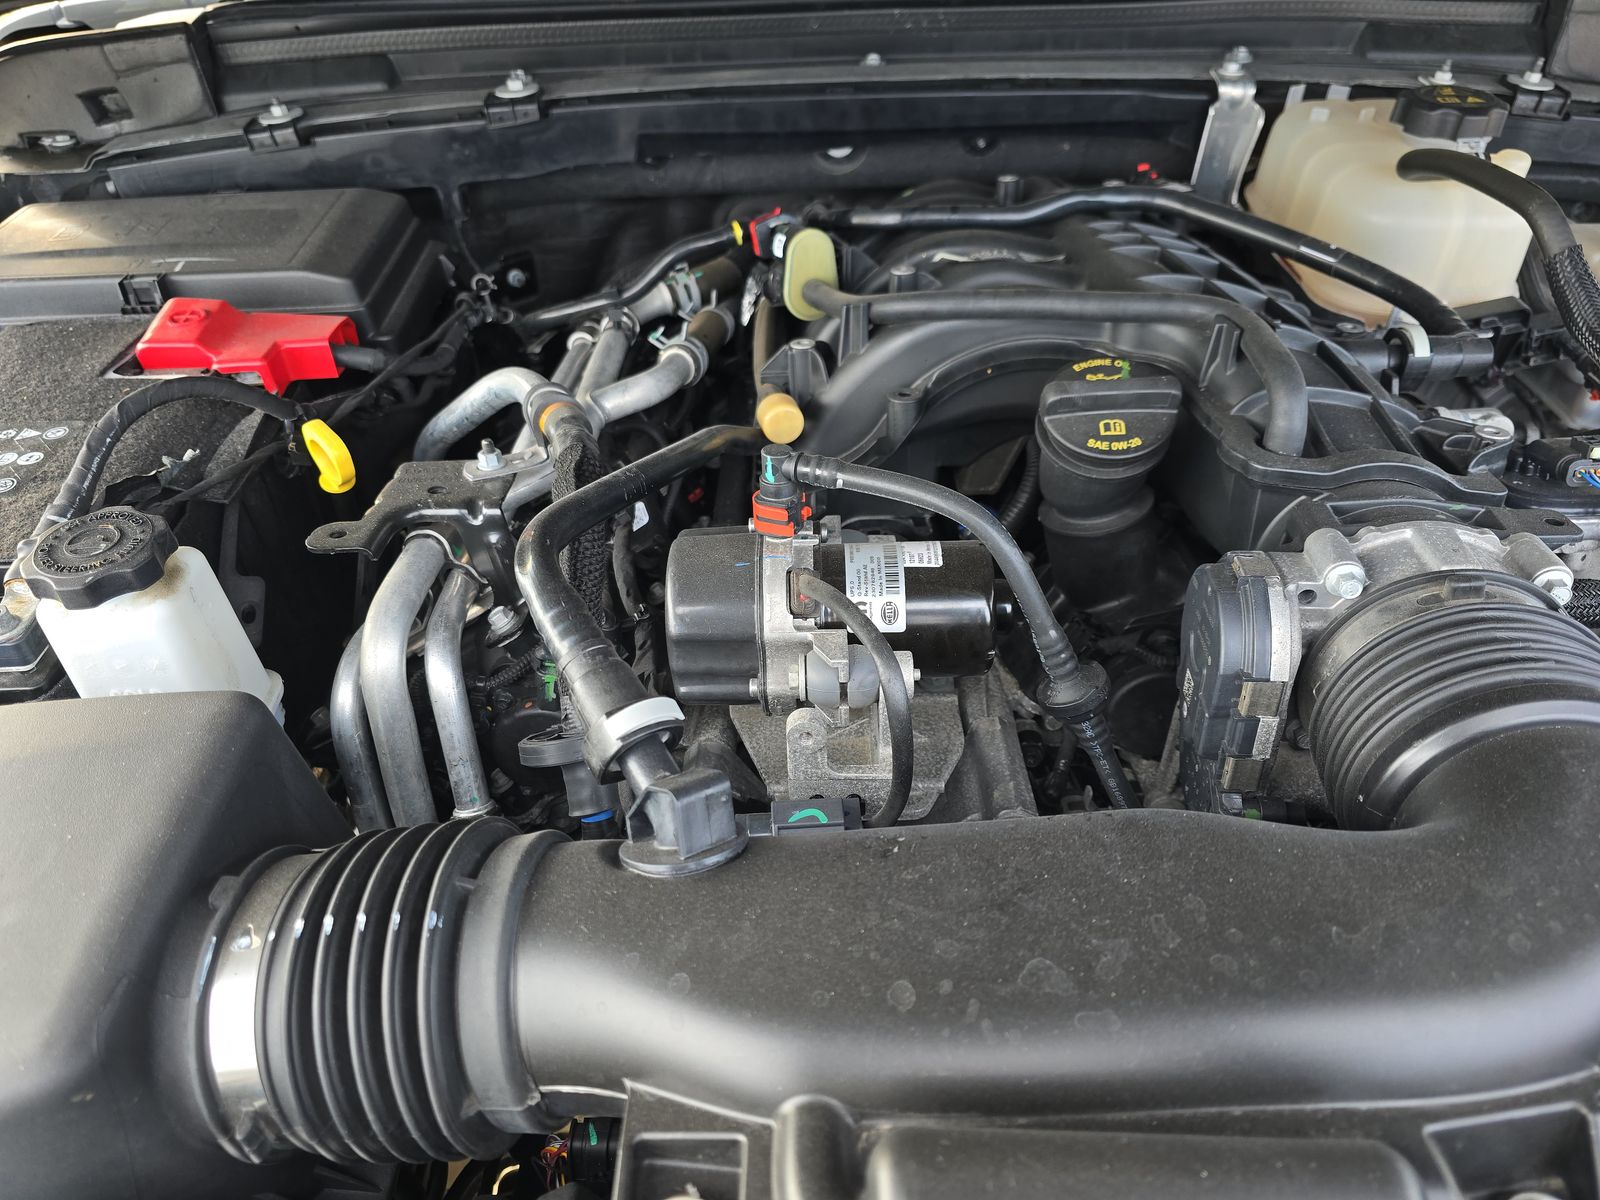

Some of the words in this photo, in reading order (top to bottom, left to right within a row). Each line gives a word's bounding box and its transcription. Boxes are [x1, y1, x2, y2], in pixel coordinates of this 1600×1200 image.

[1072, 359, 1112, 372] ENGINE
[1087, 438, 1110, 450] SAE
[1111, 437, 1142, 450] 0W-20
[88, 511, 143, 526] APPROVED
[38, 543, 54, 569] POWER
[54, 558, 112, 573] STEERING
